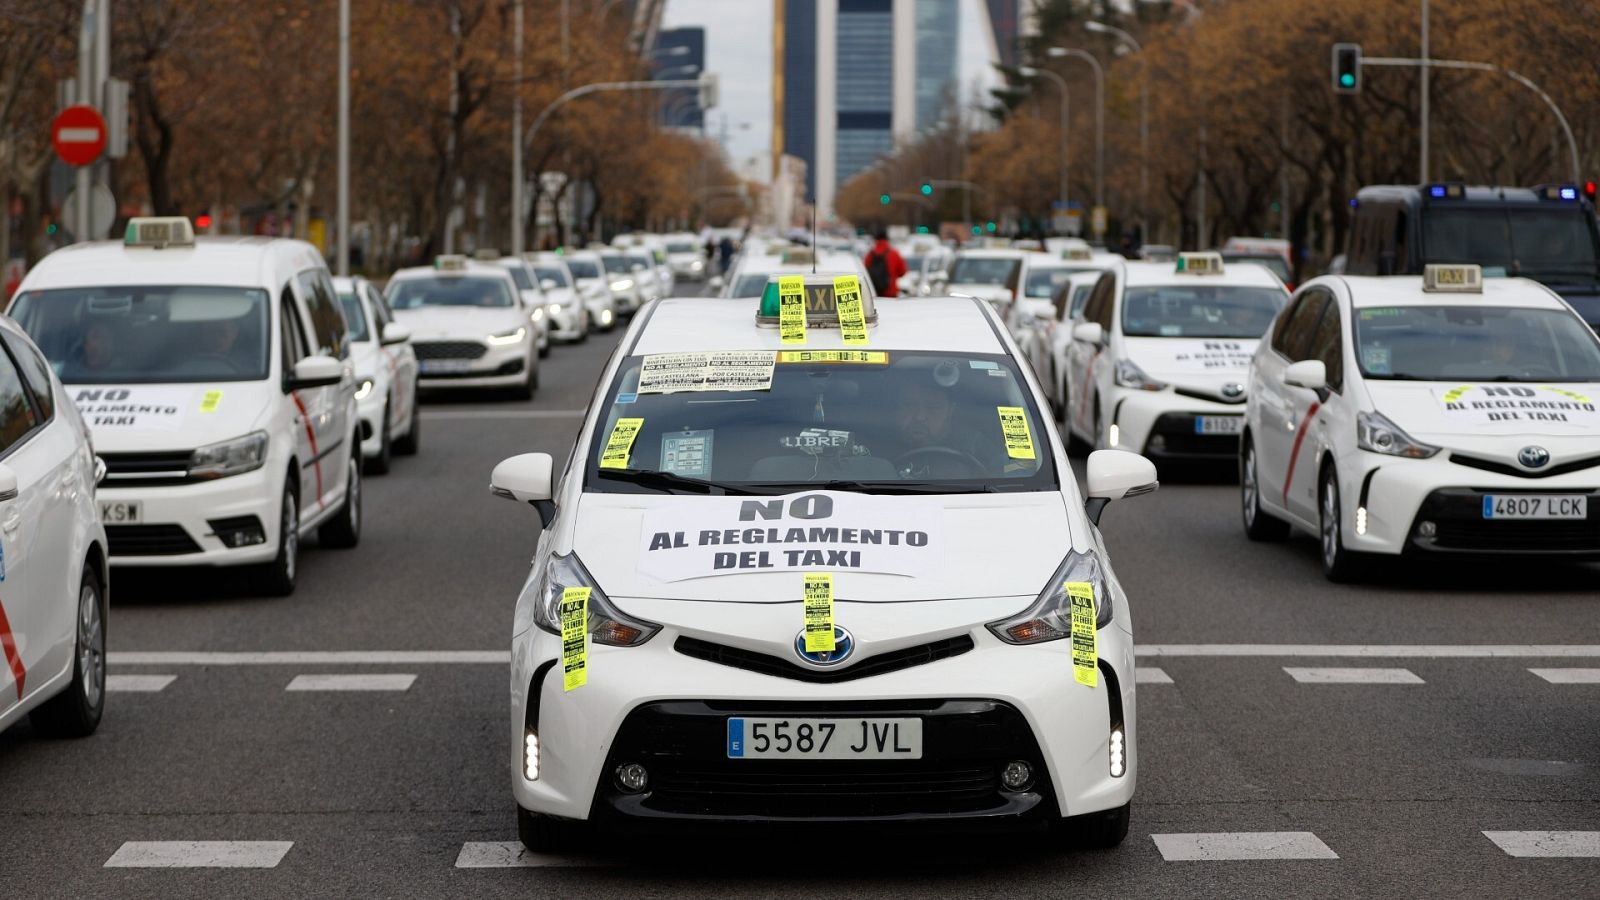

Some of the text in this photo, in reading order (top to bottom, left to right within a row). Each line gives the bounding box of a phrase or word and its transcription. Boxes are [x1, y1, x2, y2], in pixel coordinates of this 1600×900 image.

[805, 288, 834, 310] AXI
[76, 389, 130, 401] NO
[1480, 386, 1536, 397] NO
[1446, 400, 1595, 412] AL REGLAMENTO
[1488, 411, 1568, 422] DEL TAXI
[786, 437, 840, 447] LIBRE
[102, 504, 136, 520] KSW
[739, 494, 833, 521] NO
[1496, 498, 1581, 515] 4807 LCK
[648, 528, 928, 551] AL REGLAMENTO
[714, 550, 860, 570] DEL TAXI
[732, 721, 912, 753] E 5587 JVL
